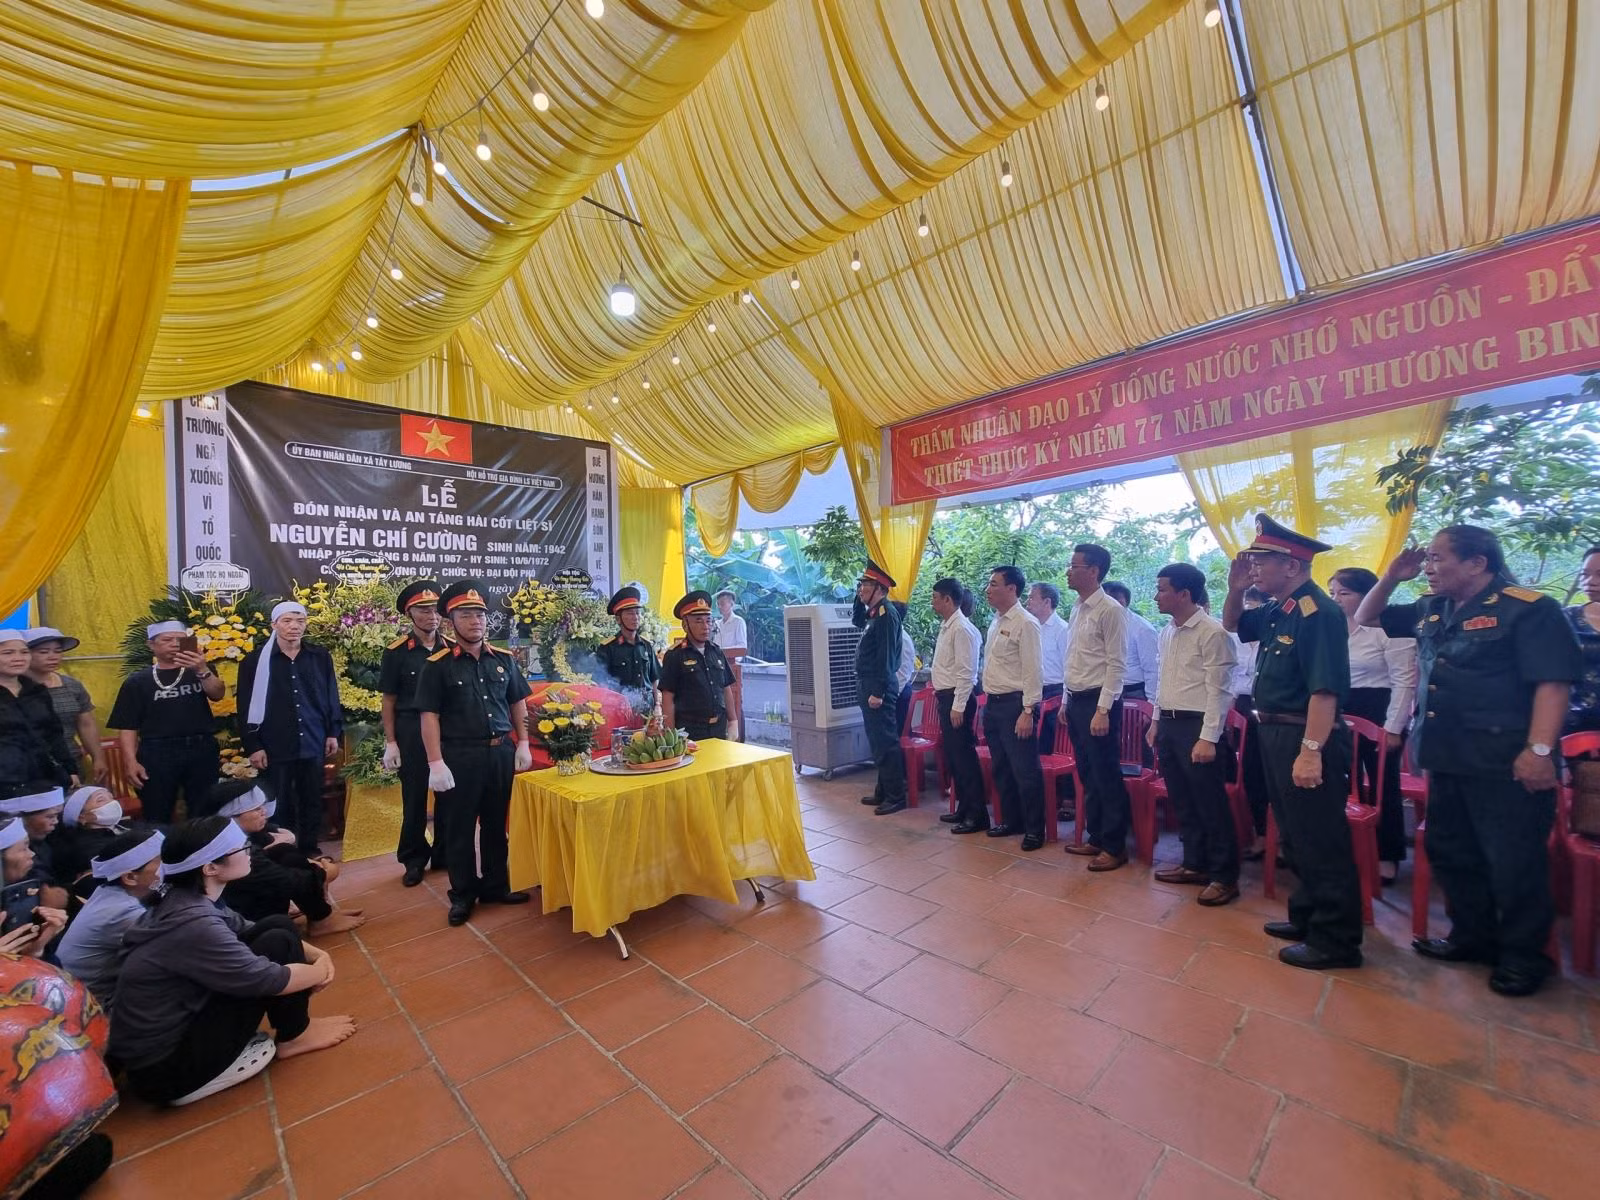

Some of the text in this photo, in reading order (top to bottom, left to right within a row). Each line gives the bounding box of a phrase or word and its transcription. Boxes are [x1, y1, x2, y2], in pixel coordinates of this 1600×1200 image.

[960, 406, 1021, 446] NHUẦN
[1028, 398, 1070, 429] ĐẠO
[1076, 384, 1103, 417] LÝ
[1111, 367, 1175, 408] UỐNG
[1185, 343, 1259, 389] NƯỚC
[1269, 316, 1338, 368] NHỚ
[1351, 283, 1482, 348] NGUỒN
[924, 452, 973, 488] THIẾT
[978, 445, 1028, 477] THỰC
[1034, 432, 1061, 466] KỶ
[1069, 422, 1127, 460] NIỆM
[1135, 414, 1163, 445] 77
[1173, 396, 1233, 436] NĂM
[1242, 374, 1328, 421] NGÀY
[1339, 336, 1500, 400] THƯƠNG
[185, 416, 225, 436] TRƯỜNG
[304, 448, 321, 458] BAN
[323, 450, 345, 461] NHÂN
[346, 452, 361, 463] DÂN
[190, 465, 223, 486] XUỐNG
[499, 474, 509, 482] GIA
[543, 480, 555, 488] NAM
[421, 479, 457, 509] LỄ
[202, 515, 214, 535] TỔ
[293, 501, 329, 517] ĐÓN
[334, 505, 378, 521] NHẬN
[382, 508, 401, 521] VÀ
[405, 511, 425, 523] AN
[428, 510, 464, 526] TÁNG
[466, 513, 488, 528] HÀI
[491, 515, 513, 529] CỐT
[515, 518, 539, 533] LIỆT
[269, 521, 566, 555] NGUYỄN CHÍ CƯỜNG SINH NĂM: 1942
[195, 541, 222, 561] QUỐC
[298, 548, 333, 561] NHẬP
[402, 552, 409, 561] 8
[412, 552, 436, 563] NĂM
[439, 555, 461, 563] 1967
[470, 556, 483, 564] HY
[485, 556, 508, 565] SINH:
[442, 567, 468, 577] CHỨC
[470, 568, 485, 579] VỤ:
[486, 569, 502, 579] ĐẠI
[503, 567, 518, 579] ĐỘI
[488, 584, 515, 595] ngày
